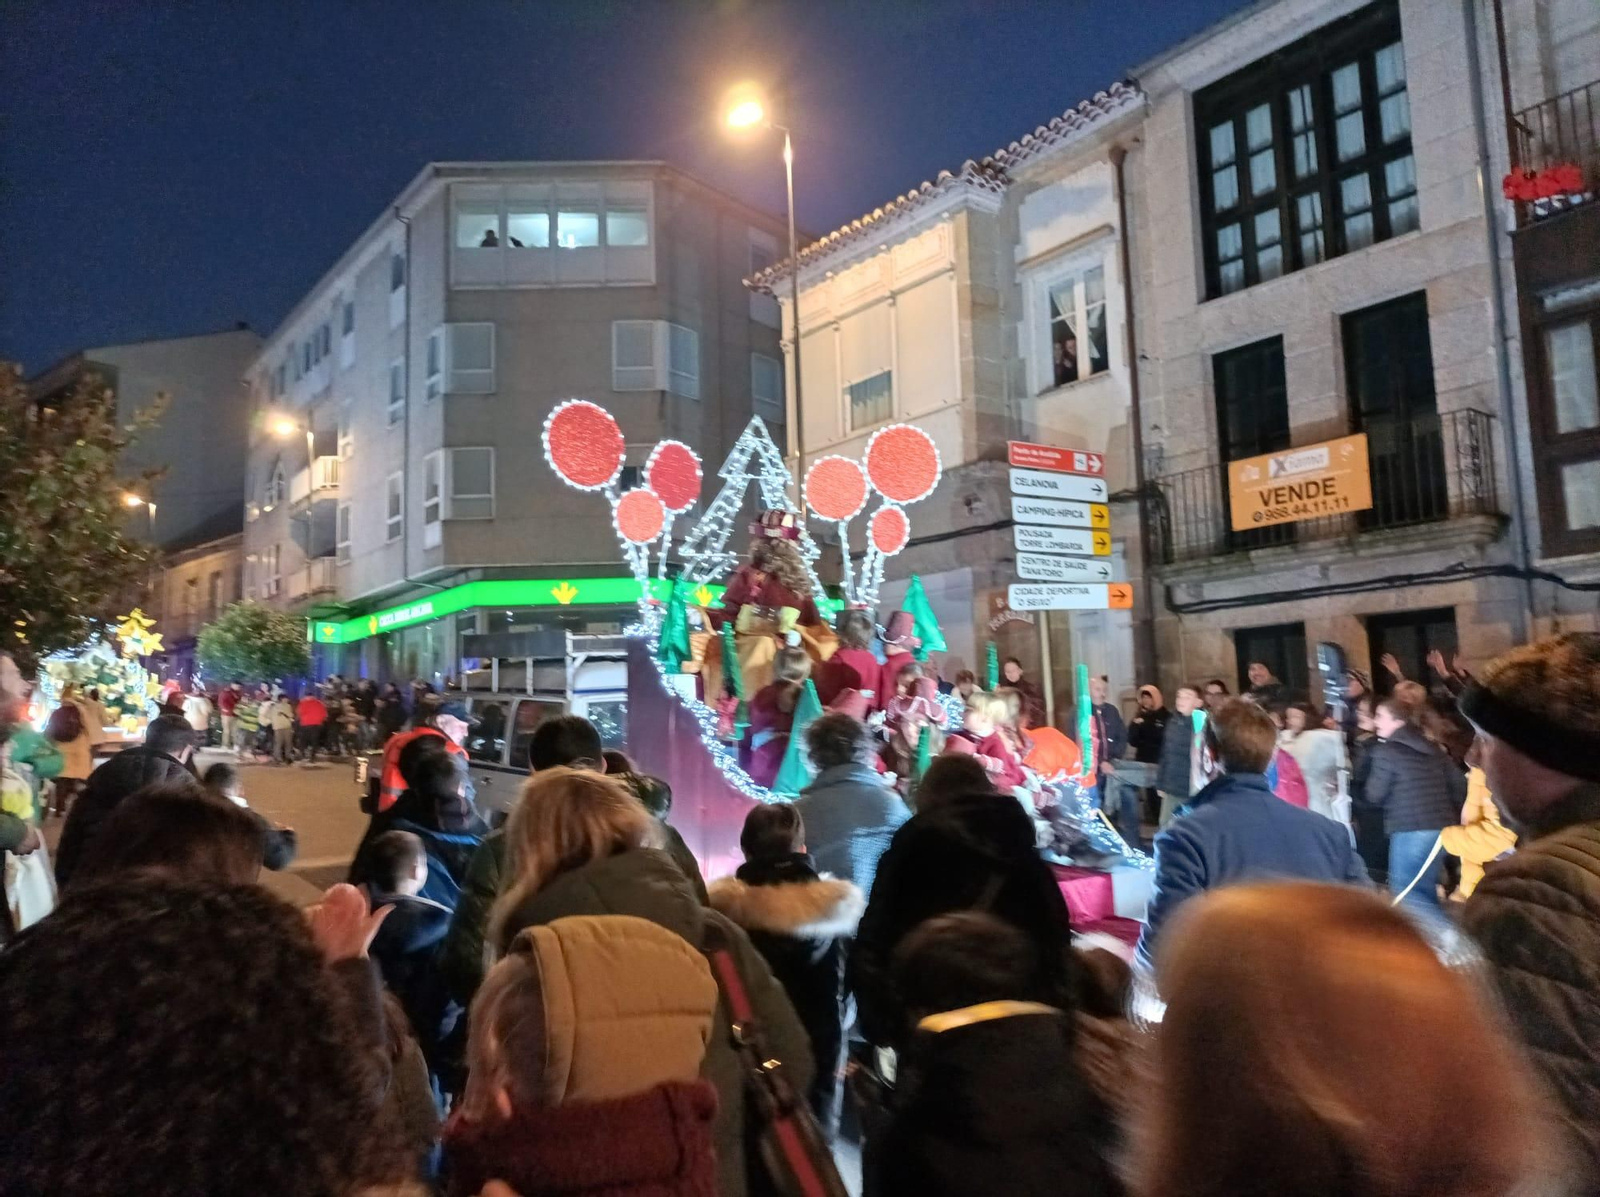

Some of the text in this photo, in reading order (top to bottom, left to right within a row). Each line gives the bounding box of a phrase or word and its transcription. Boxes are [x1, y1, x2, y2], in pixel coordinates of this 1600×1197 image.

[1014, 476, 1059, 490] CELANOVA
[1259, 477, 1338, 507] VENDE
[1018, 528, 1054, 539] POUSADA
[1019, 538, 1043, 549] TORRE
[1020, 556, 1052, 567] CENTRO
[1052, 558, 1063, 569] DE
[1021, 566, 1064, 578] TANATORIO
[1014, 587, 1091, 596] CIDADE DEPORTIVA
